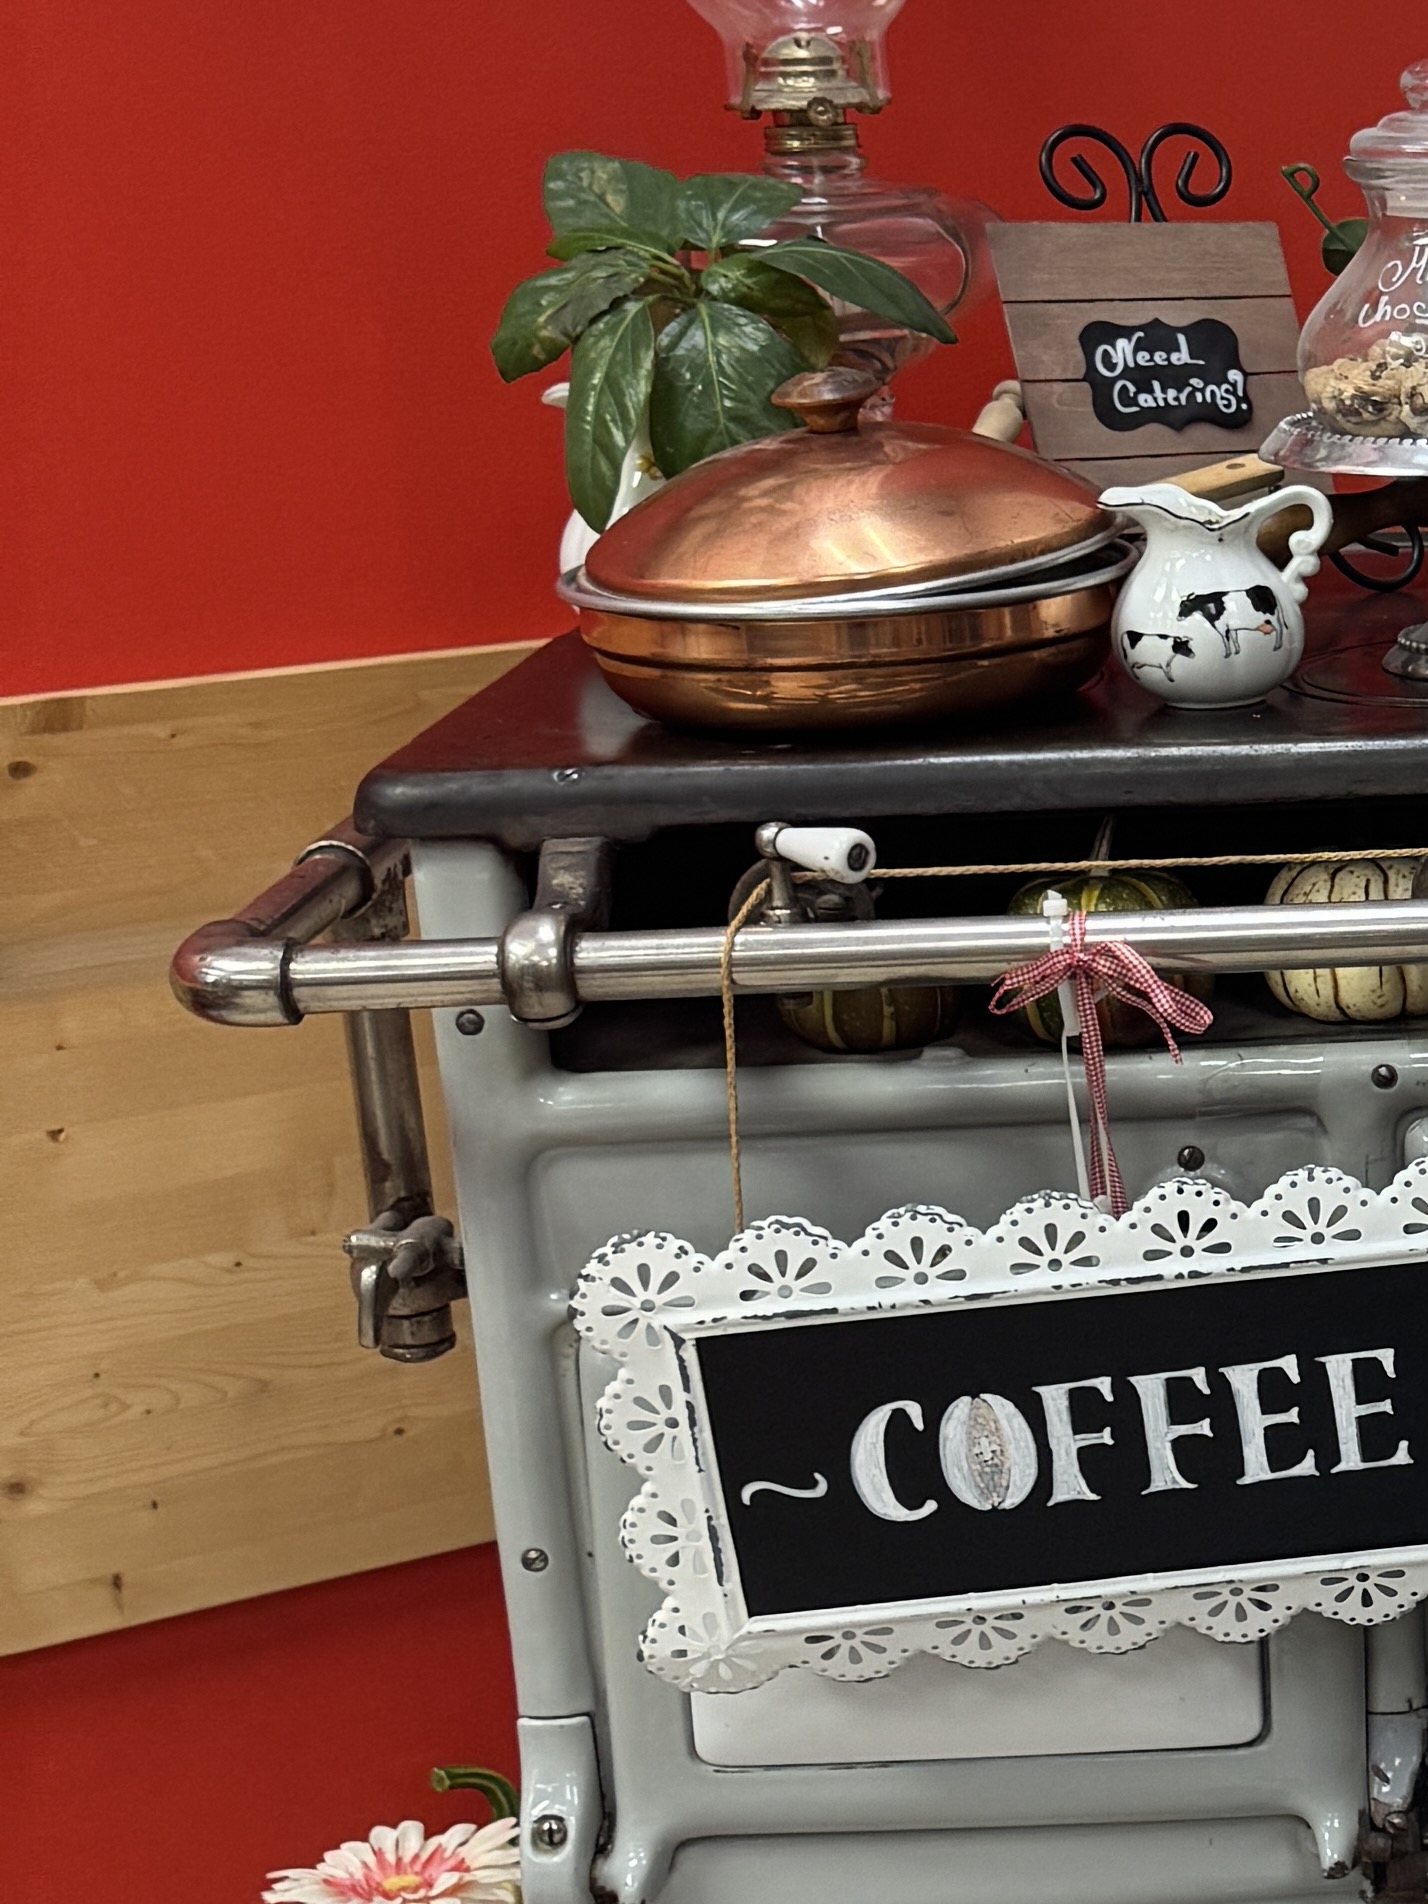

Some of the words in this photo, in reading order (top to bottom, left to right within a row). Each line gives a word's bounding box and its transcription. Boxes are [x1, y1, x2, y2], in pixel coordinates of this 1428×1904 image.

[1095, 331, 1206, 377] Need
[1113, 369, 1248, 414] Catering?
[849, 1347, 1414, 1522] COFFEE
